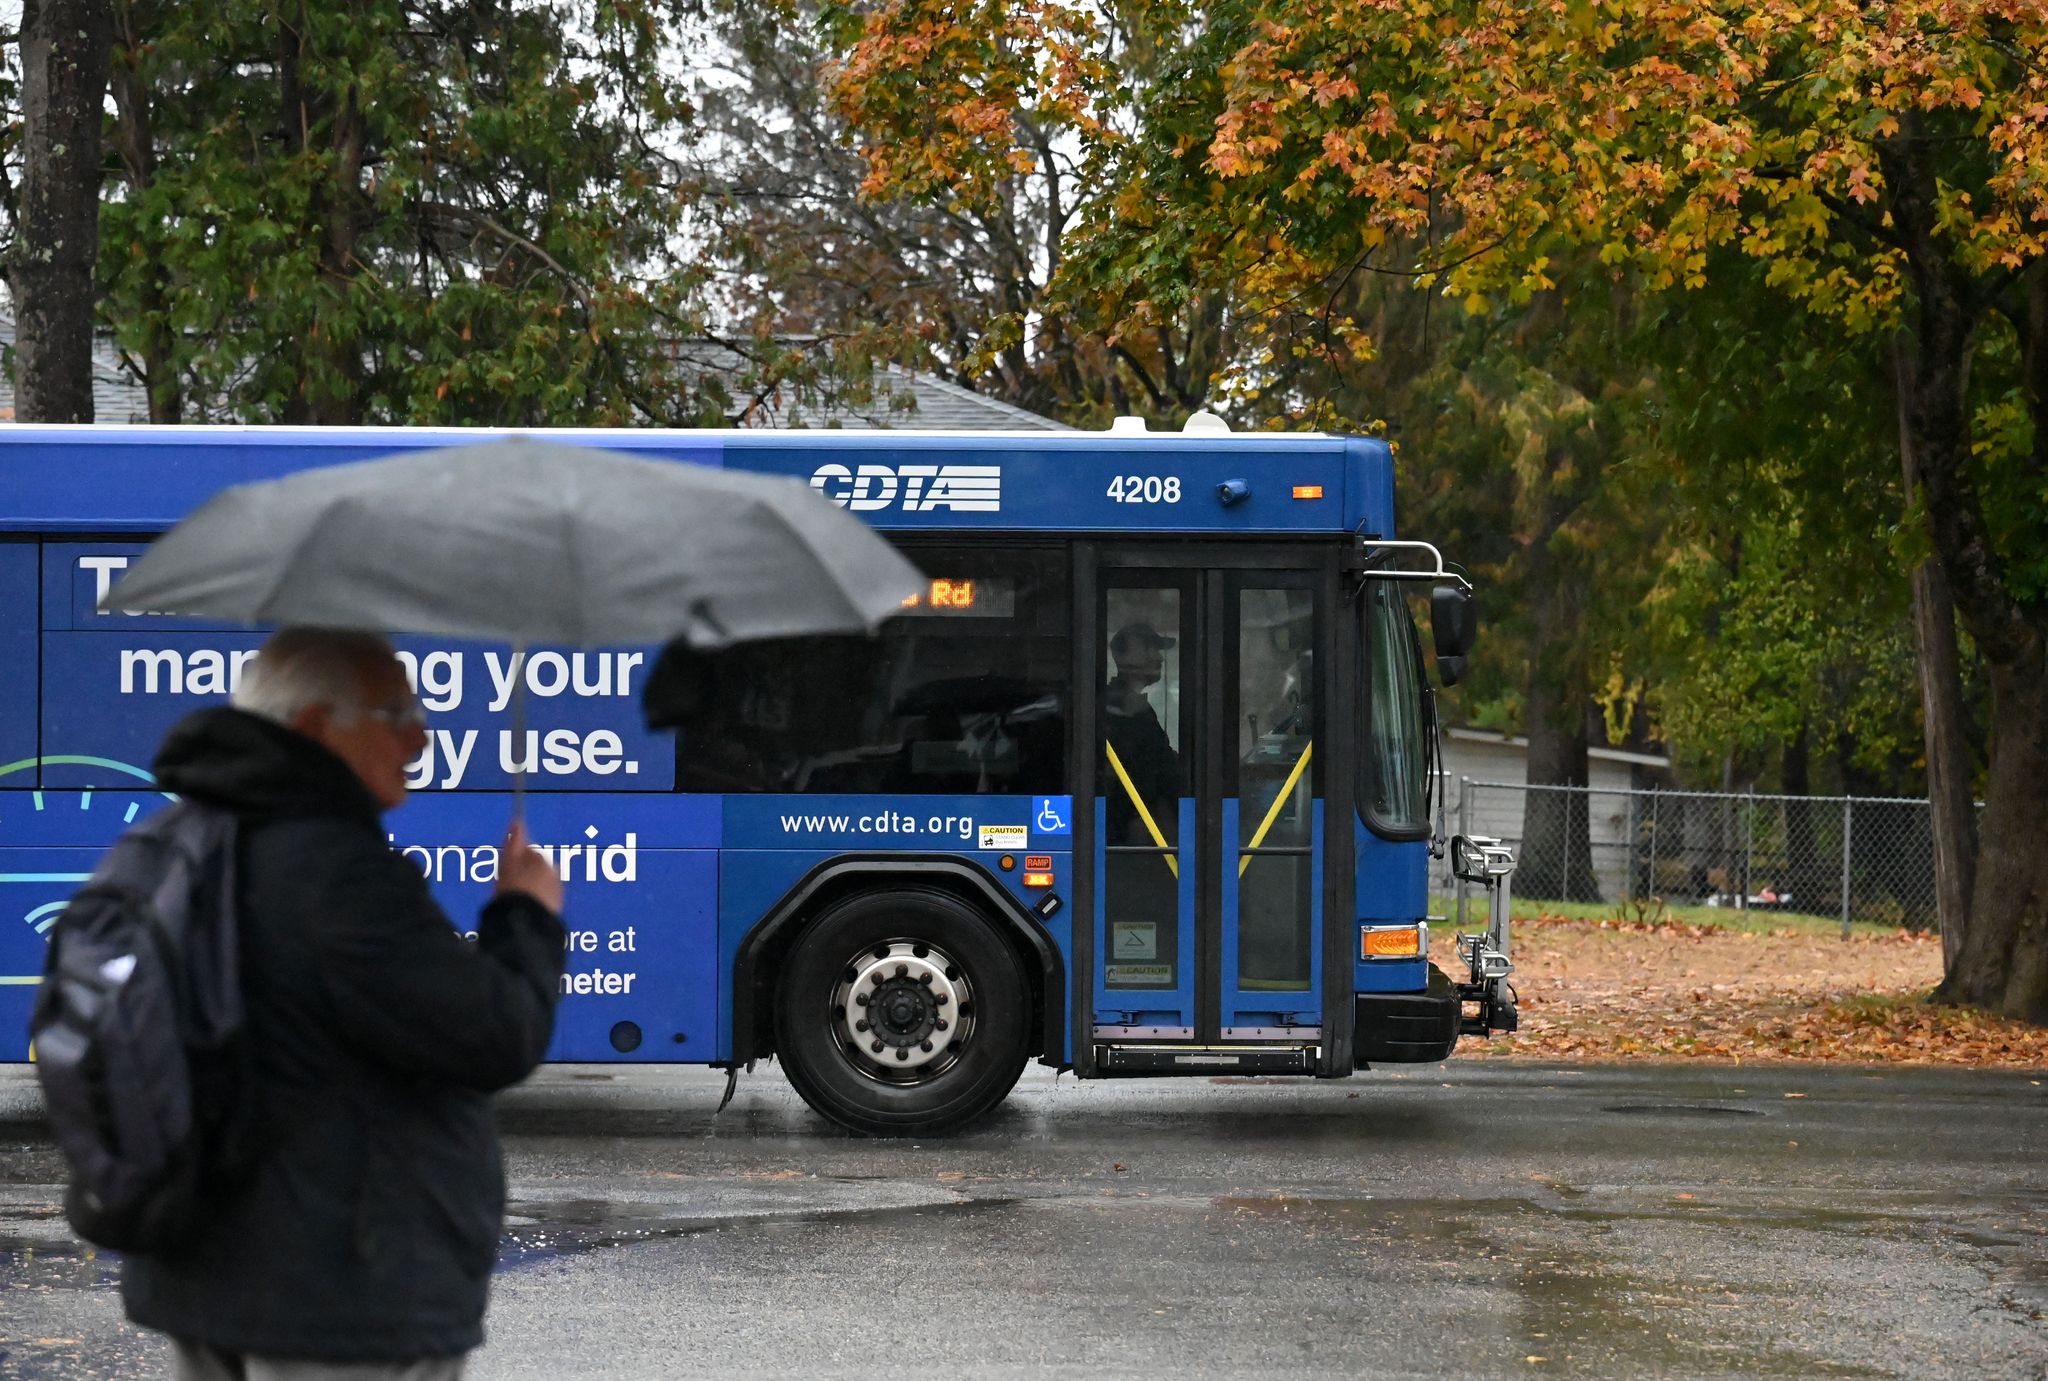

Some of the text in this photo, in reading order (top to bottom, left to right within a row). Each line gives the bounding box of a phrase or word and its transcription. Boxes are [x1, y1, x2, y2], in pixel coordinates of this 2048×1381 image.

[810, 464, 1001, 511] CDTA
[1106, 475, 1181, 503] 4208
[930, 580, 972, 606] Rd
[484, 651, 643, 711] your
[499, 729, 639, 774] use.
[780, 810, 973, 840] www.cdta.org
[1027, 858, 1049, 867] RAMP
[608, 926, 636, 952] at
